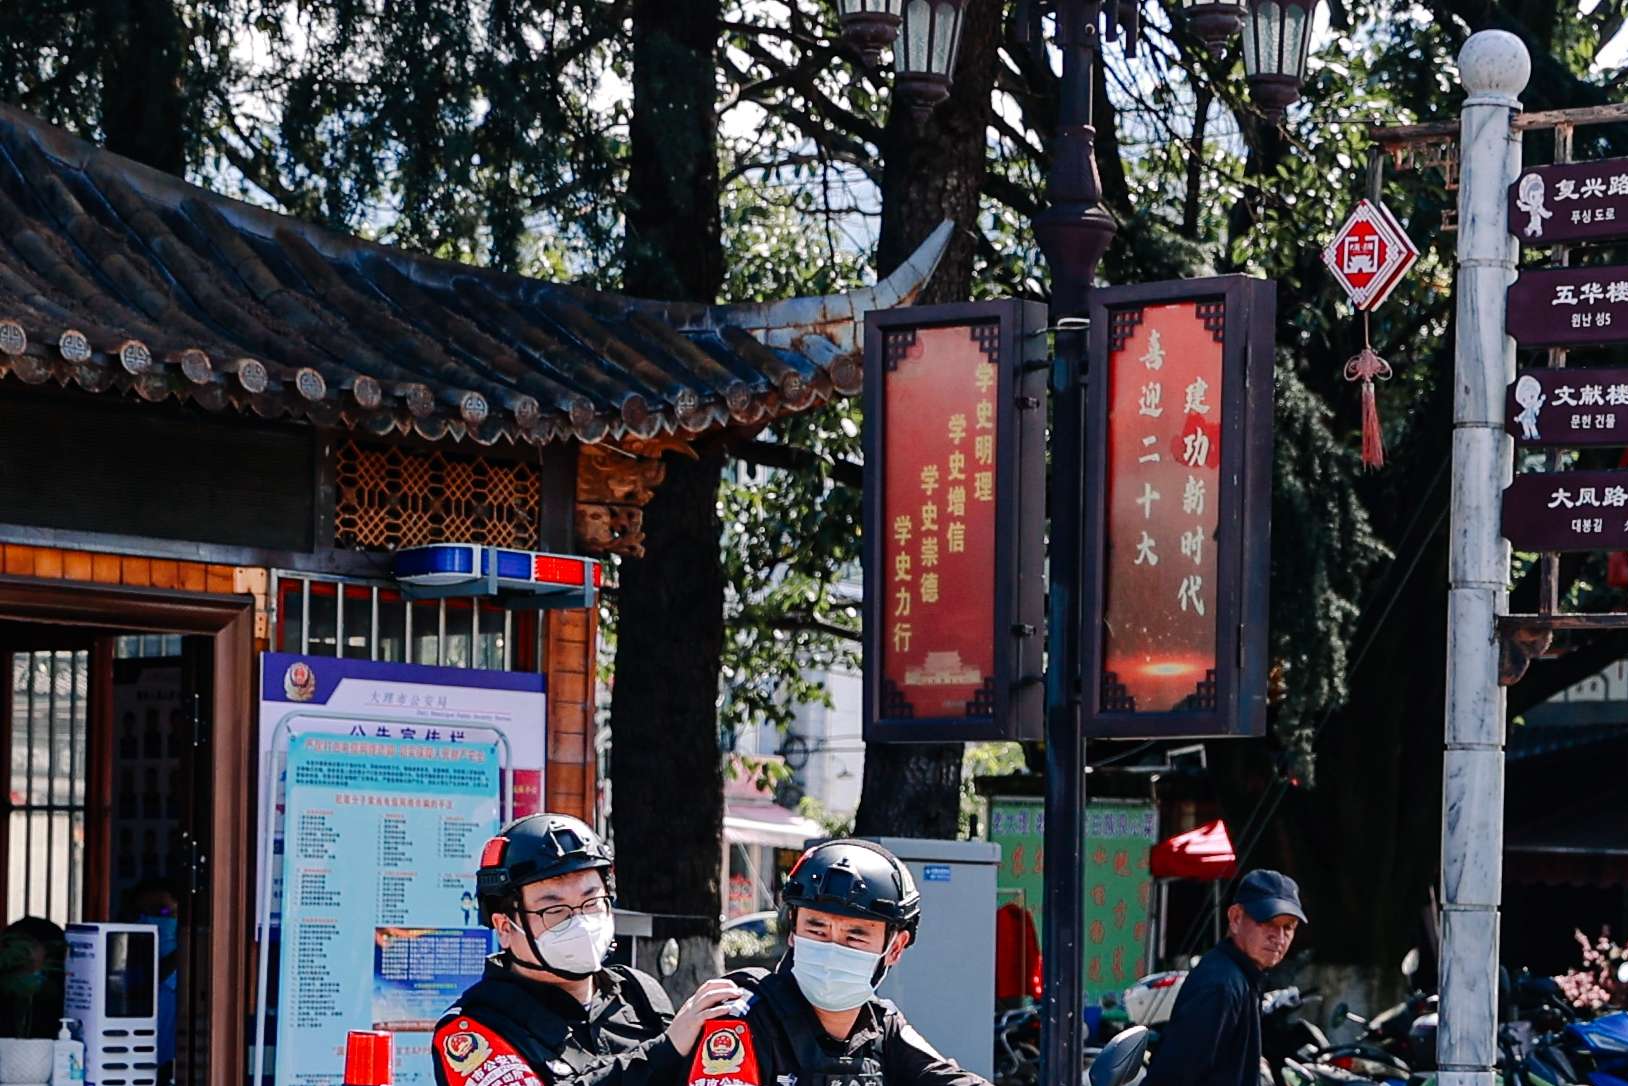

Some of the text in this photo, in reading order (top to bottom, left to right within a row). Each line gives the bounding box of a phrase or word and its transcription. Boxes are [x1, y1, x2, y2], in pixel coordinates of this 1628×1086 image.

[1594, 207, 1616, 222] 도로
[946, 413, 967, 554] 学史增信
[973, 362, 995, 502] 学史明理
[1133, 328, 1168, 568] 喜迎二十大
[1177, 376, 1212, 617] 建功新时代
[893, 515, 913, 654] 学史力行
[920, 464, 940, 605] 学史崇德
